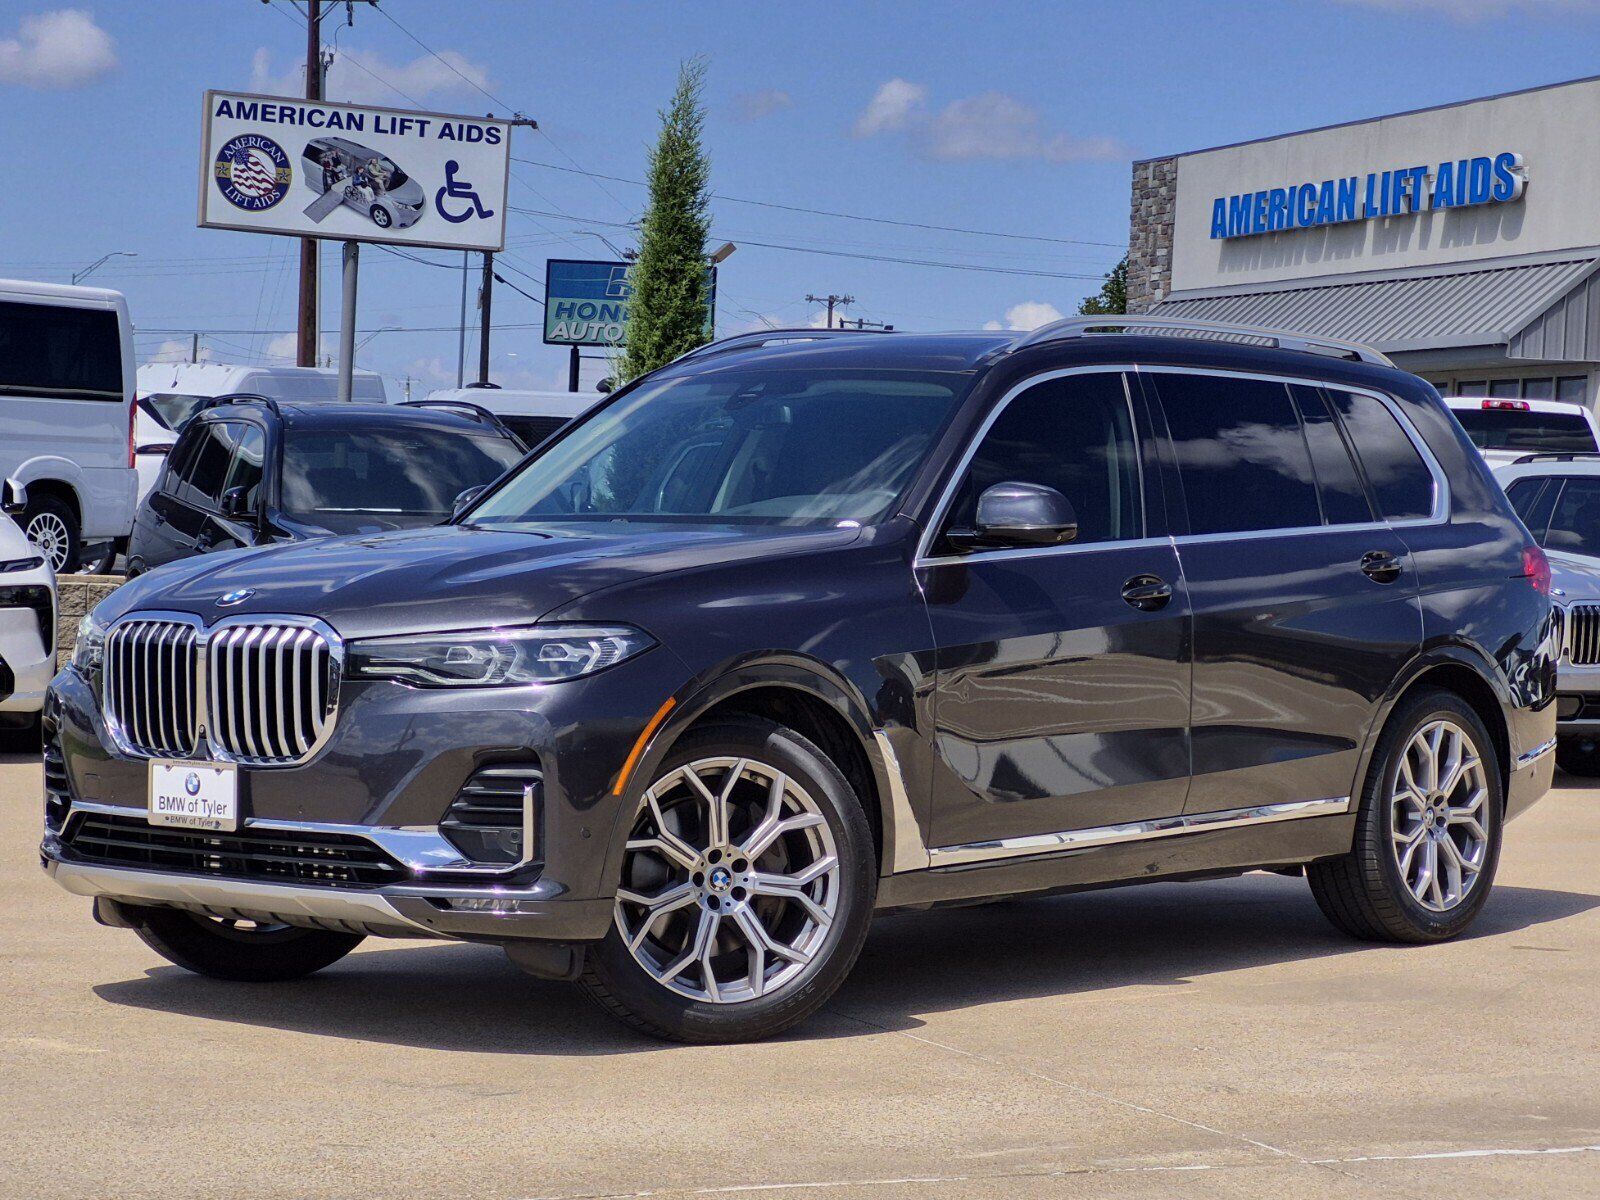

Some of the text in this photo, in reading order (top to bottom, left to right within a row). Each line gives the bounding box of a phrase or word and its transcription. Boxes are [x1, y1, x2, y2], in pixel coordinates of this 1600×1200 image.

[215, 99, 502, 145] AMERICAN LIFT AIDS
[223, 136, 285, 164] AMERICAN
[225, 185, 281, 208] LIFT AIDS
[1210, 152, 1517, 240] AMERICAN LIFT AIDS
[158, 796, 228, 818] BMW of Tyler
[170, 816, 215, 827] BMW of Tyler
